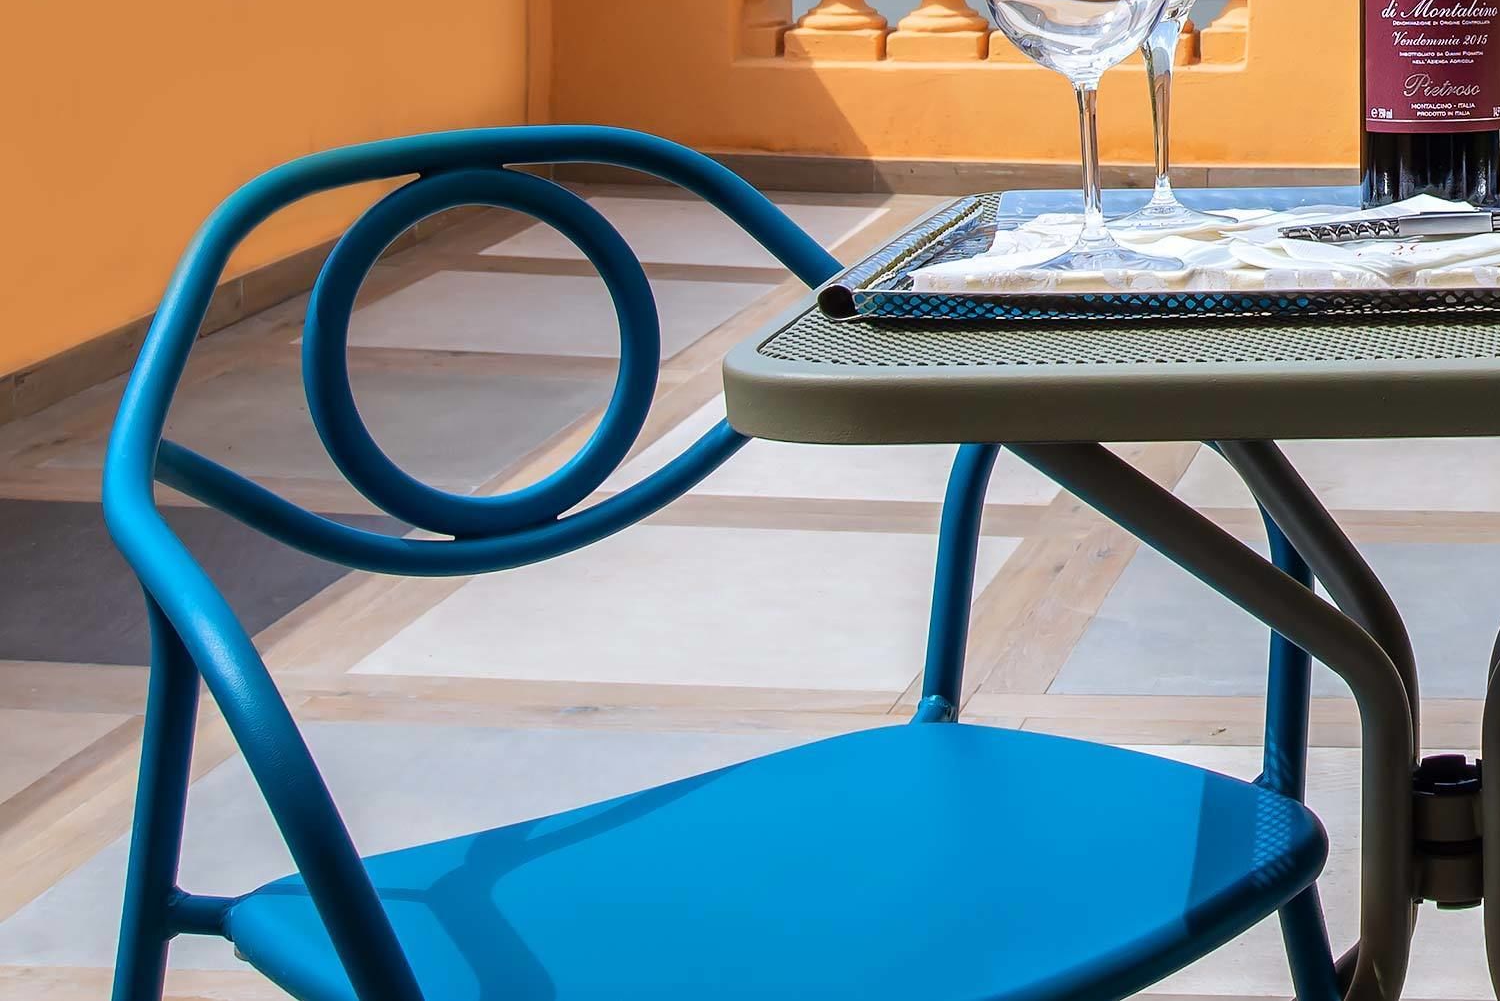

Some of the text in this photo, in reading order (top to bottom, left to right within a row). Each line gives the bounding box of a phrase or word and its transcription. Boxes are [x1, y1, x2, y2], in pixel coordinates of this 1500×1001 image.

[1381, 0, 1398, 18] di
[1391, 31, 1489, 46] Vendemmia 2015
[1403, 73, 1480, 97] Pietroso
